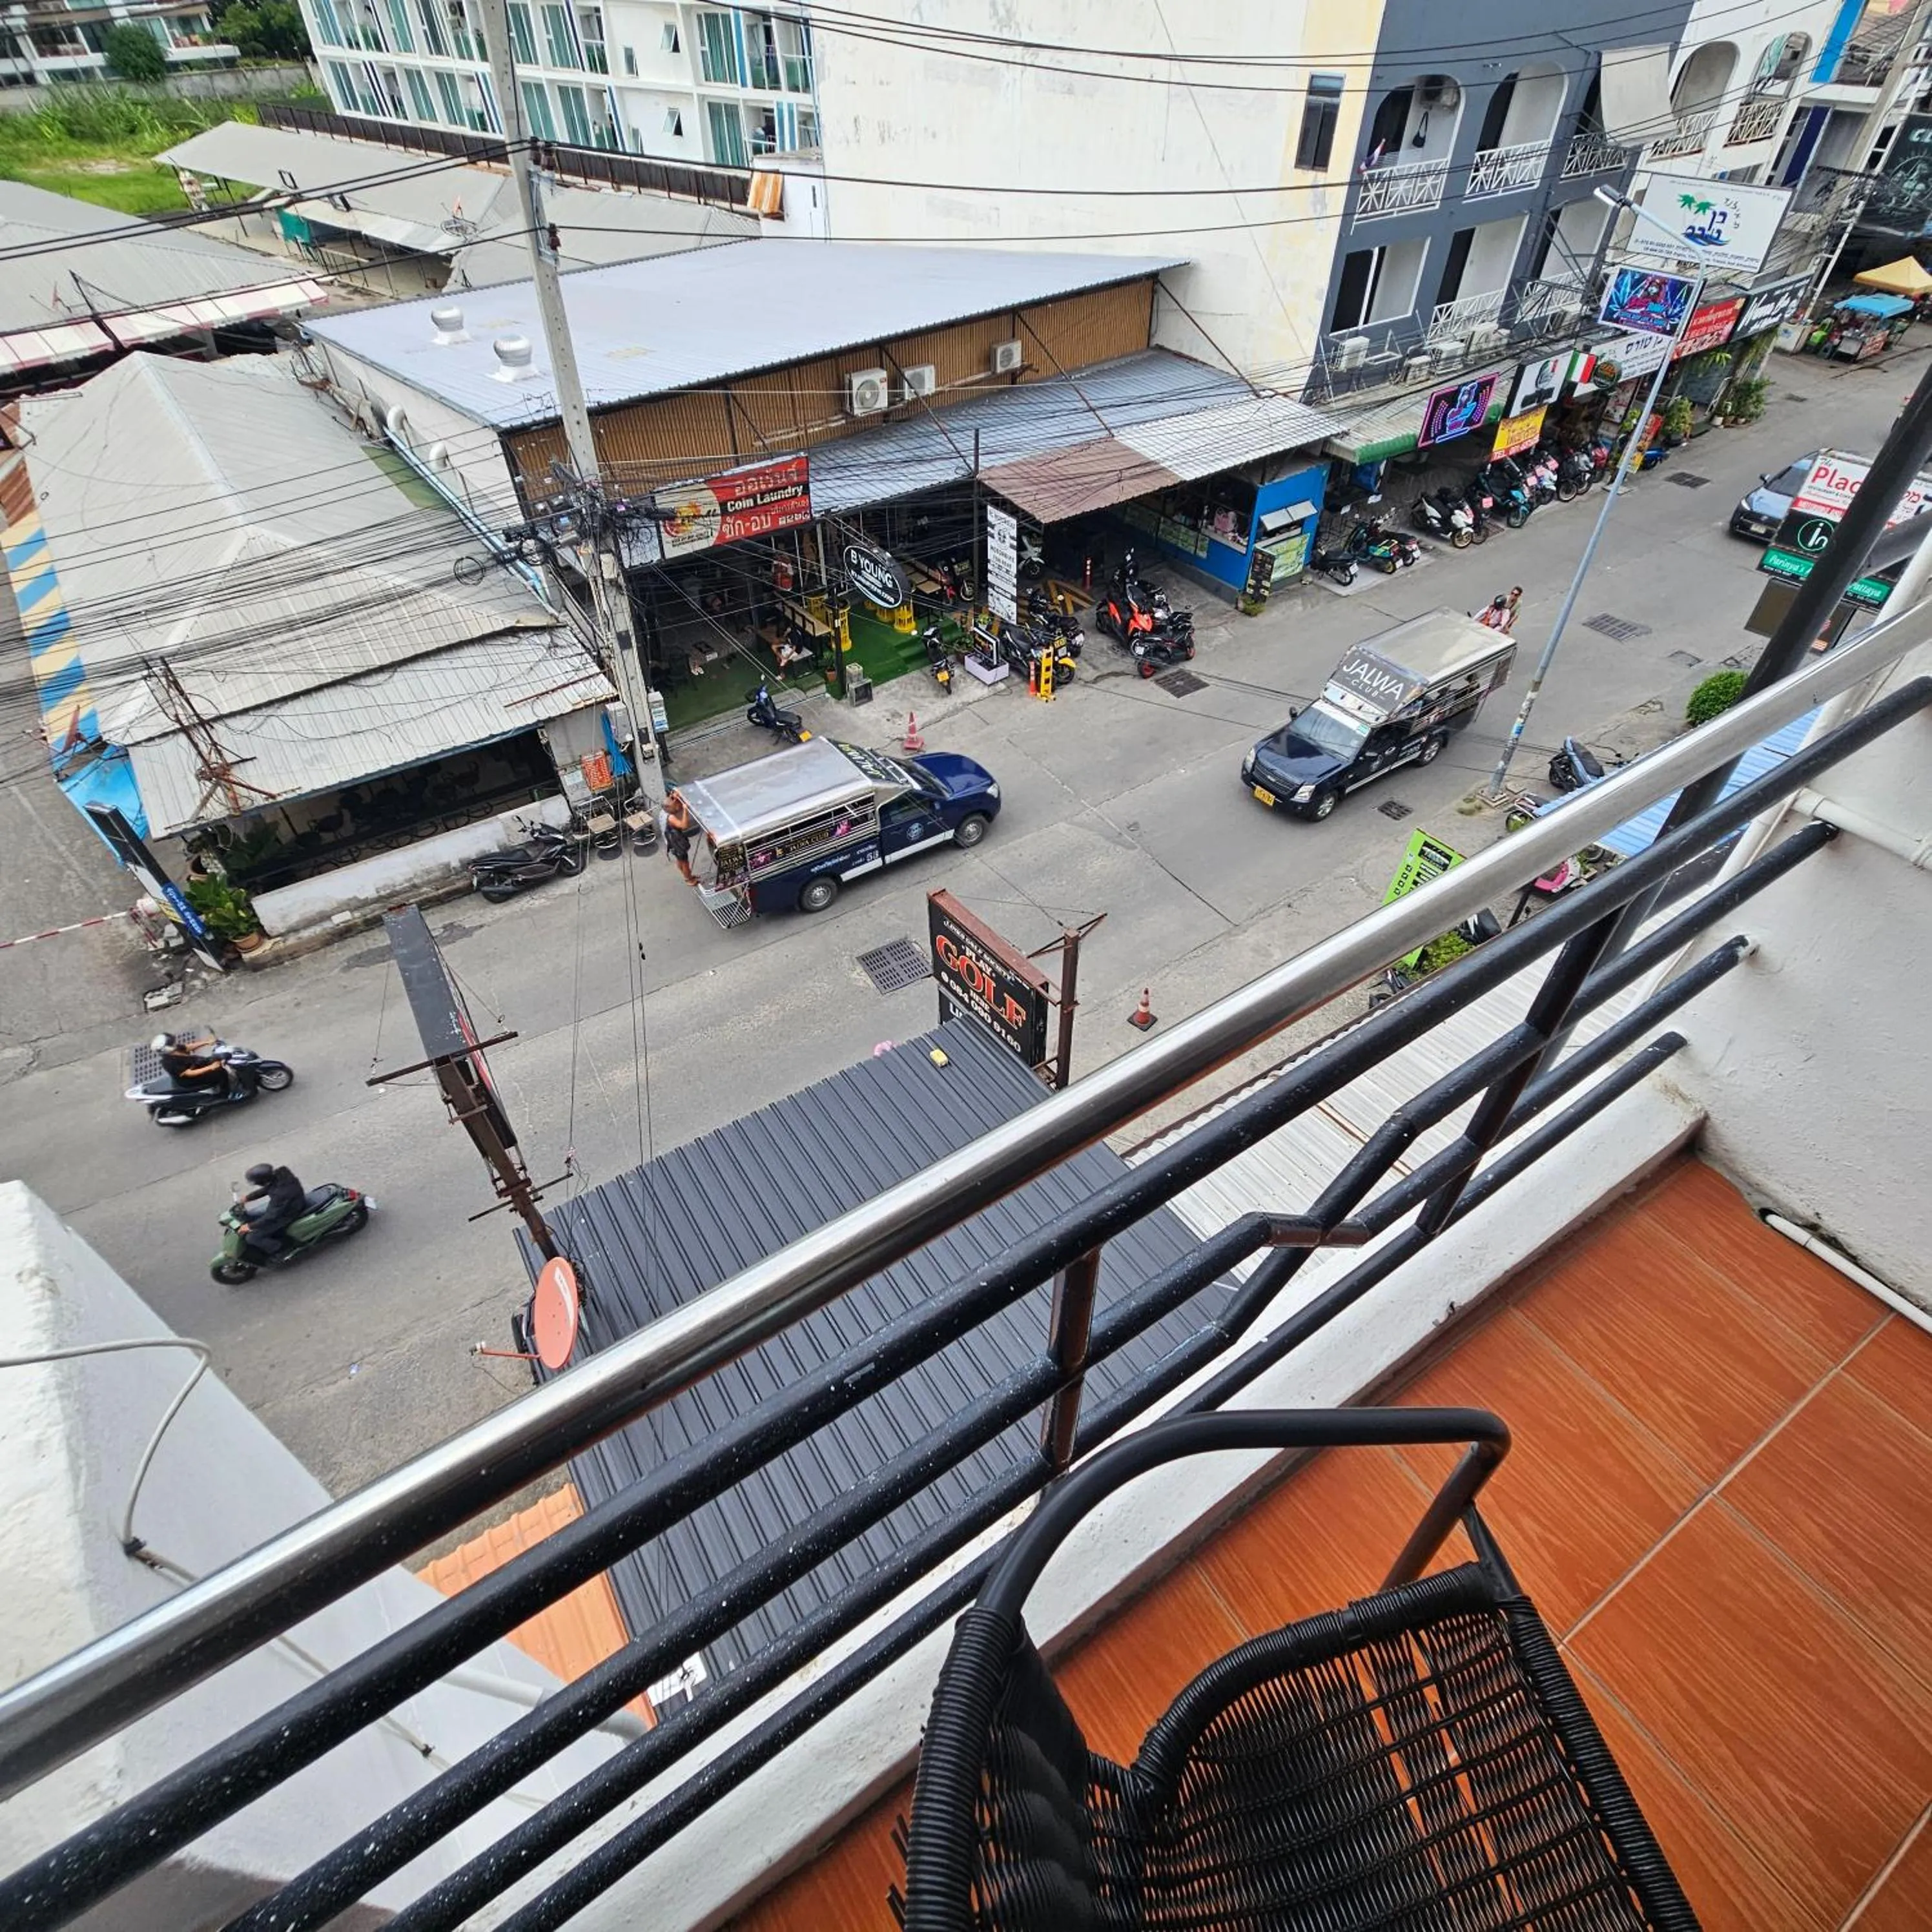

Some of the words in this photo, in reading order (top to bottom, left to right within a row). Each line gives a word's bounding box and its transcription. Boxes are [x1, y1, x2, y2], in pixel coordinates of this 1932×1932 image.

[1811, 466, 1863, 495] Plac
[727, 498, 754, 512] Coin
[756, 485, 803, 504] Laundry
[850, 549, 857, 564] B
[858, 553, 893, 588] YOUNG
[1343, 659, 1405, 701] JALWA
[1351, 679, 1379, 697] CLUB
[965, 946, 993, 977] PLAY
[936, 934, 1027, 1031] GOLF
